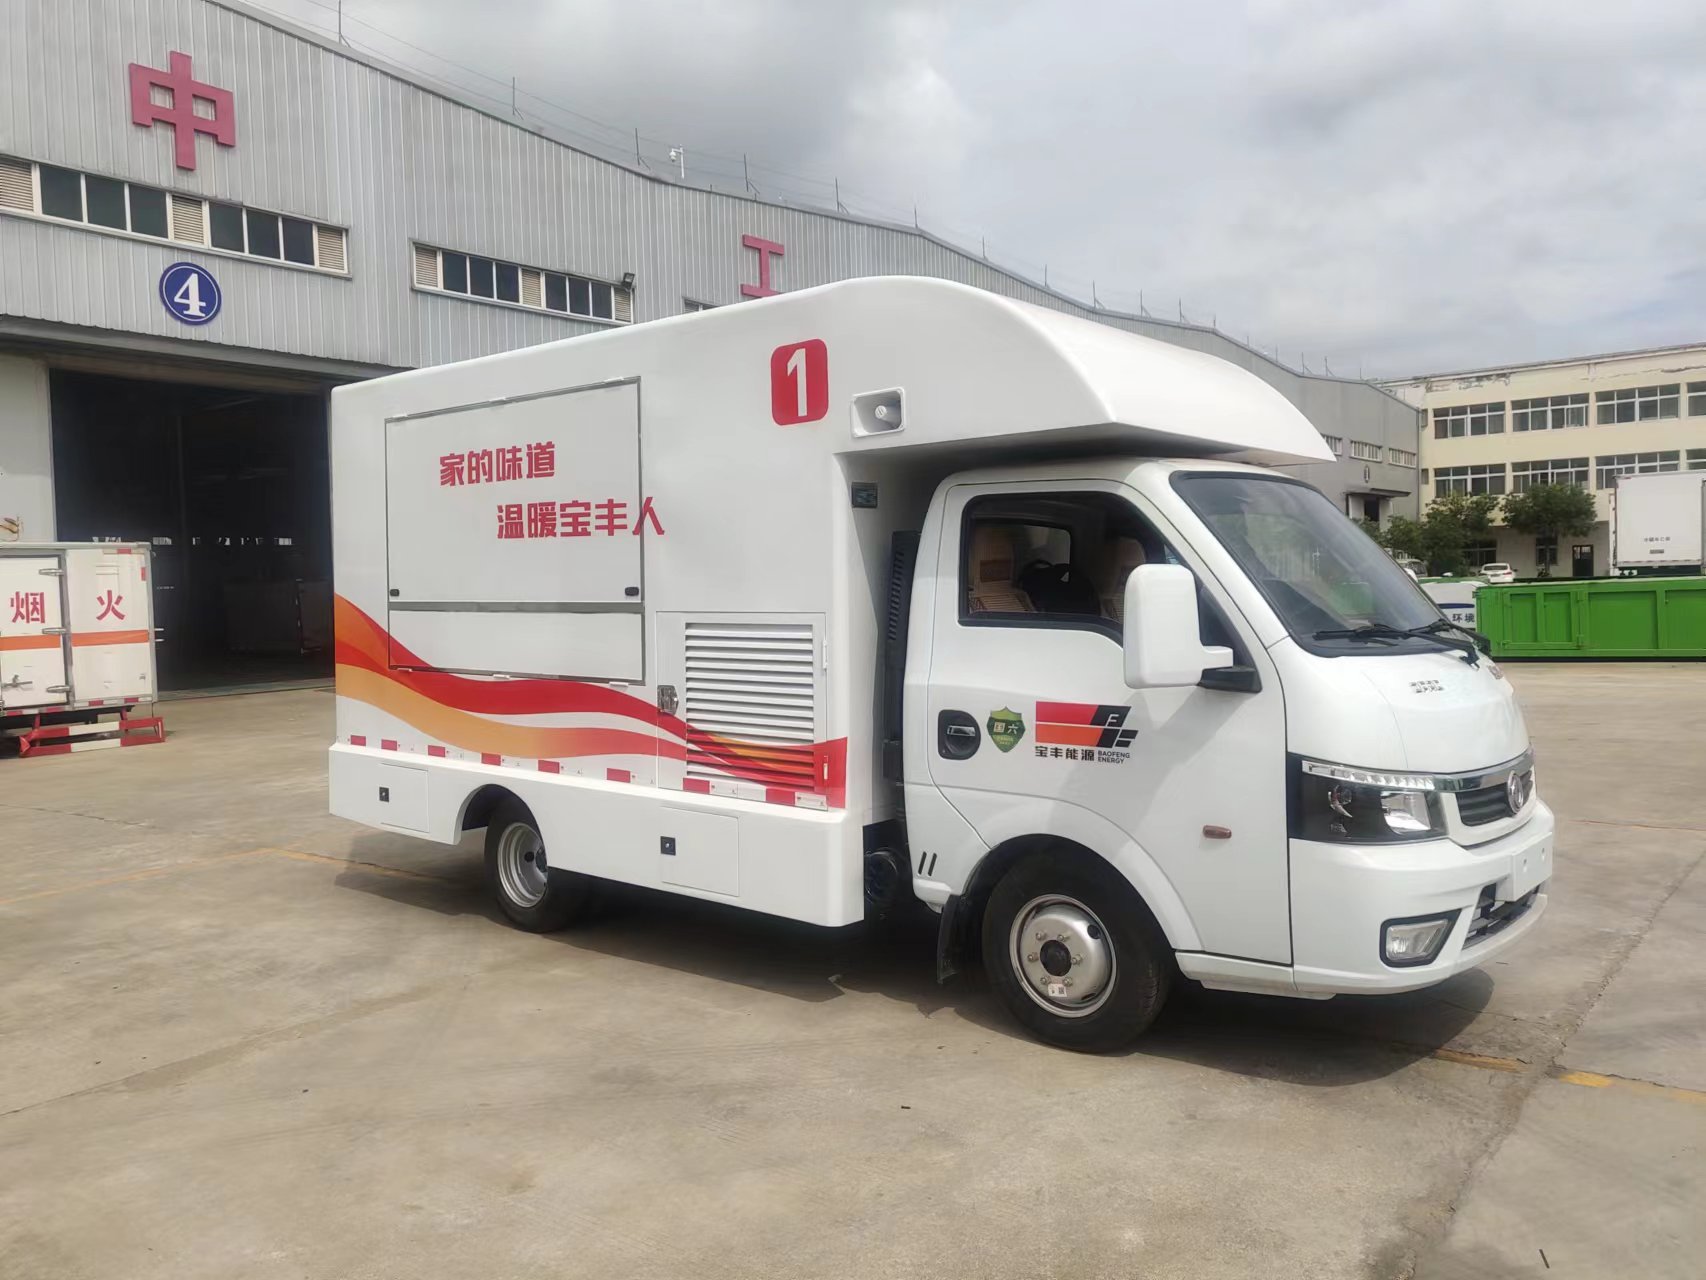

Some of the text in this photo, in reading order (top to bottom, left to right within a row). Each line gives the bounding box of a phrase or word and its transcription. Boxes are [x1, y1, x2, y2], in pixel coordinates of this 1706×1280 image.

[129, 51, 235, 170] 中
[741, 235, 785, 298] 工
[172, 273, 207, 318] 4
[787, 348, 808, 417] 1
[440, 441, 555, 487] 家的味道
[497, 496, 665, 539] 温暖宝丰人
[1035, 746, 1095, 761] 宝丰能源
[1098, 750, 1130, 758] BAOFENG
